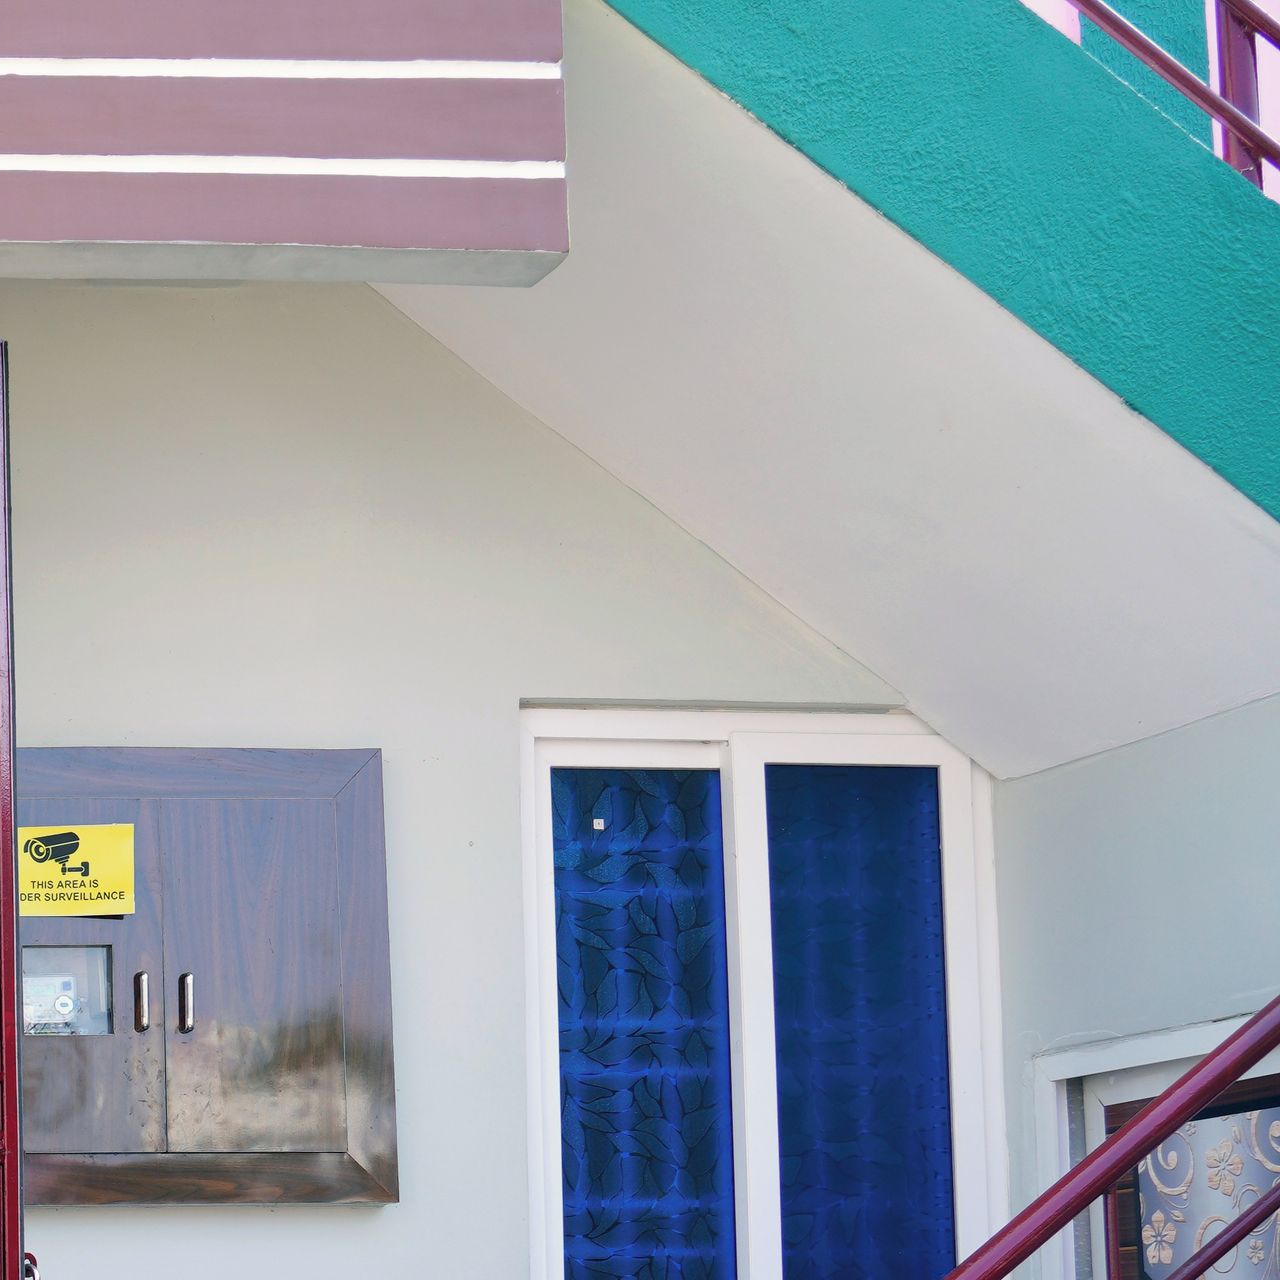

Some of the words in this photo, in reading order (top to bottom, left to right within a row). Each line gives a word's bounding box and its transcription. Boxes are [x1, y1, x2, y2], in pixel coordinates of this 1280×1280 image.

[30, 880, 54, 889] THIS
[57, 880, 86, 889] AREA
[89, 879, 99, 888] IS
[19, 892, 41, 902] DER
[44, 891, 125, 901] SURVEILLANCE
